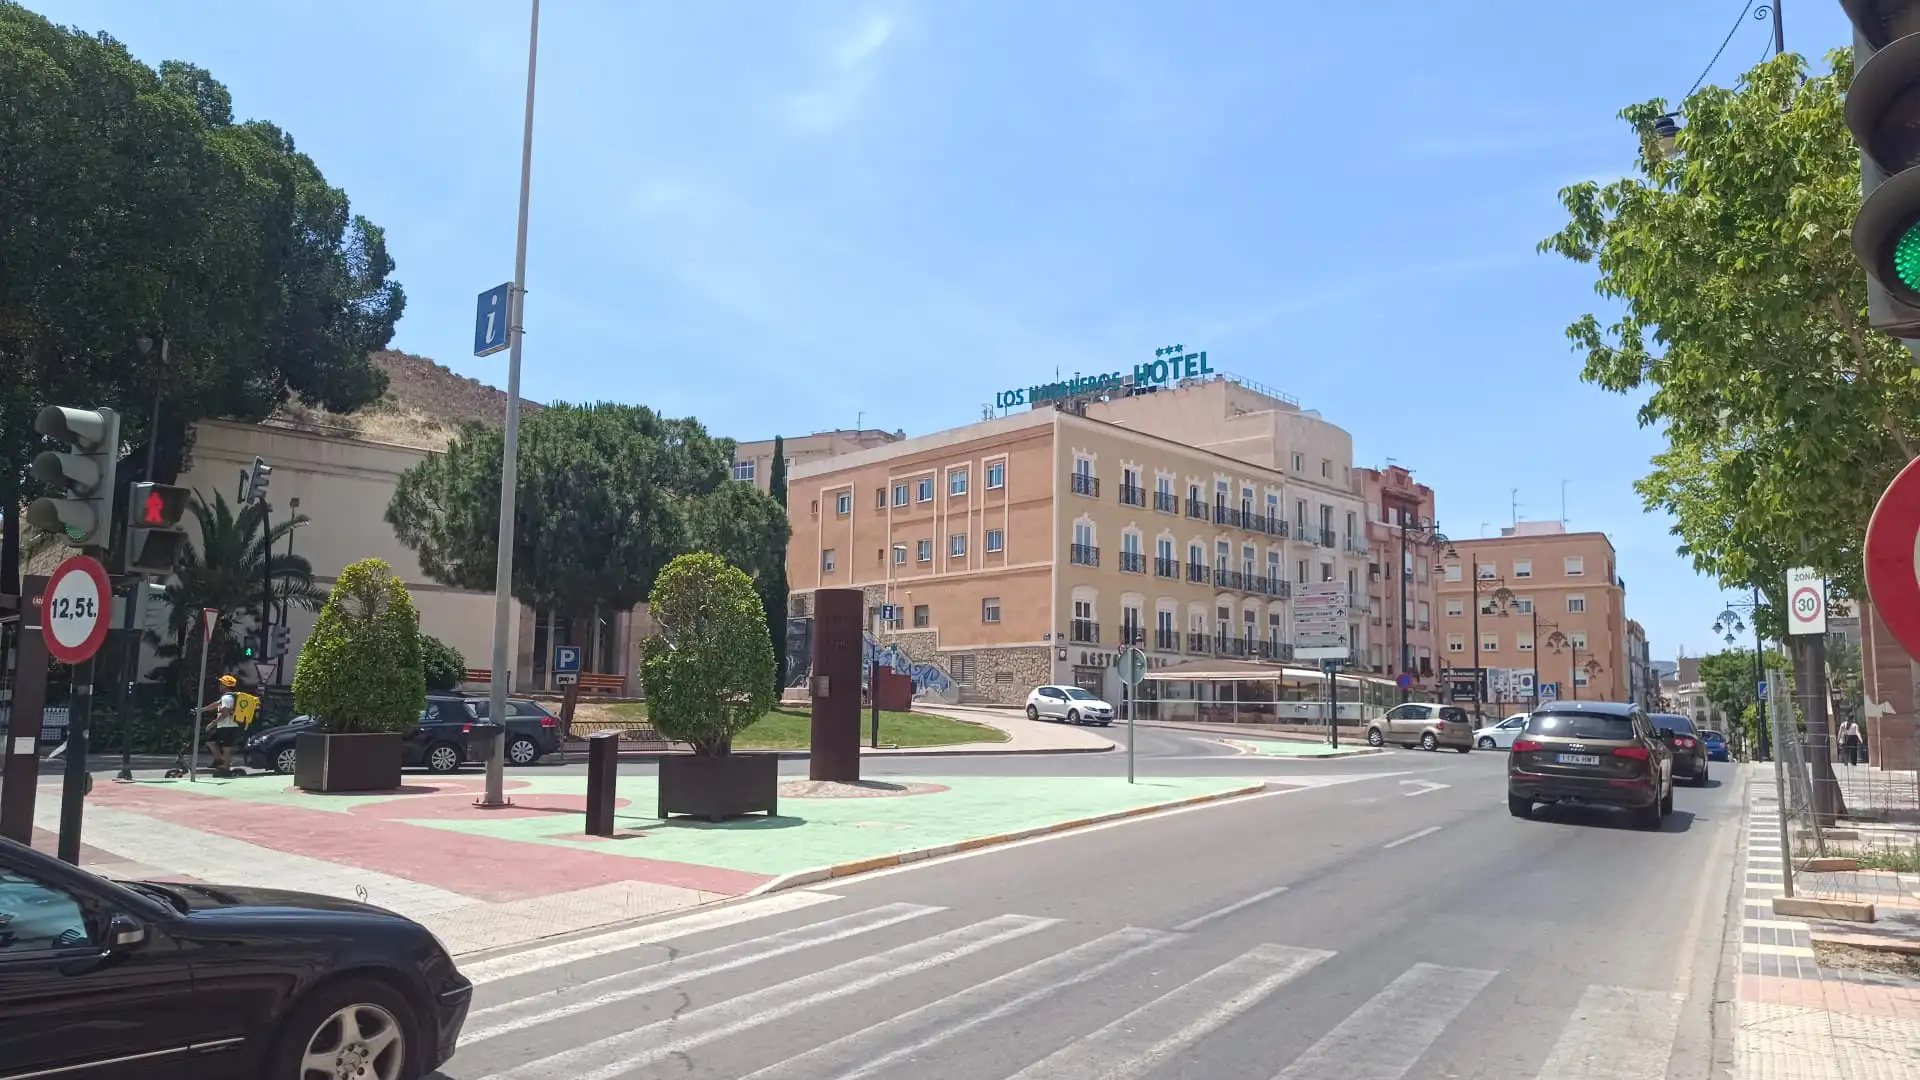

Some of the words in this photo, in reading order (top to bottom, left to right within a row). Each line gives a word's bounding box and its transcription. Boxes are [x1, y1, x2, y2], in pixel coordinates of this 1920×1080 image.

[996, 388, 1024, 409] LOS
[1133, 351, 1214, 388] HOTEL
[1793, 572, 1817, 582] ZONA
[1798, 597, 1815, 611] 30
[560, 649, 575, 668] P
